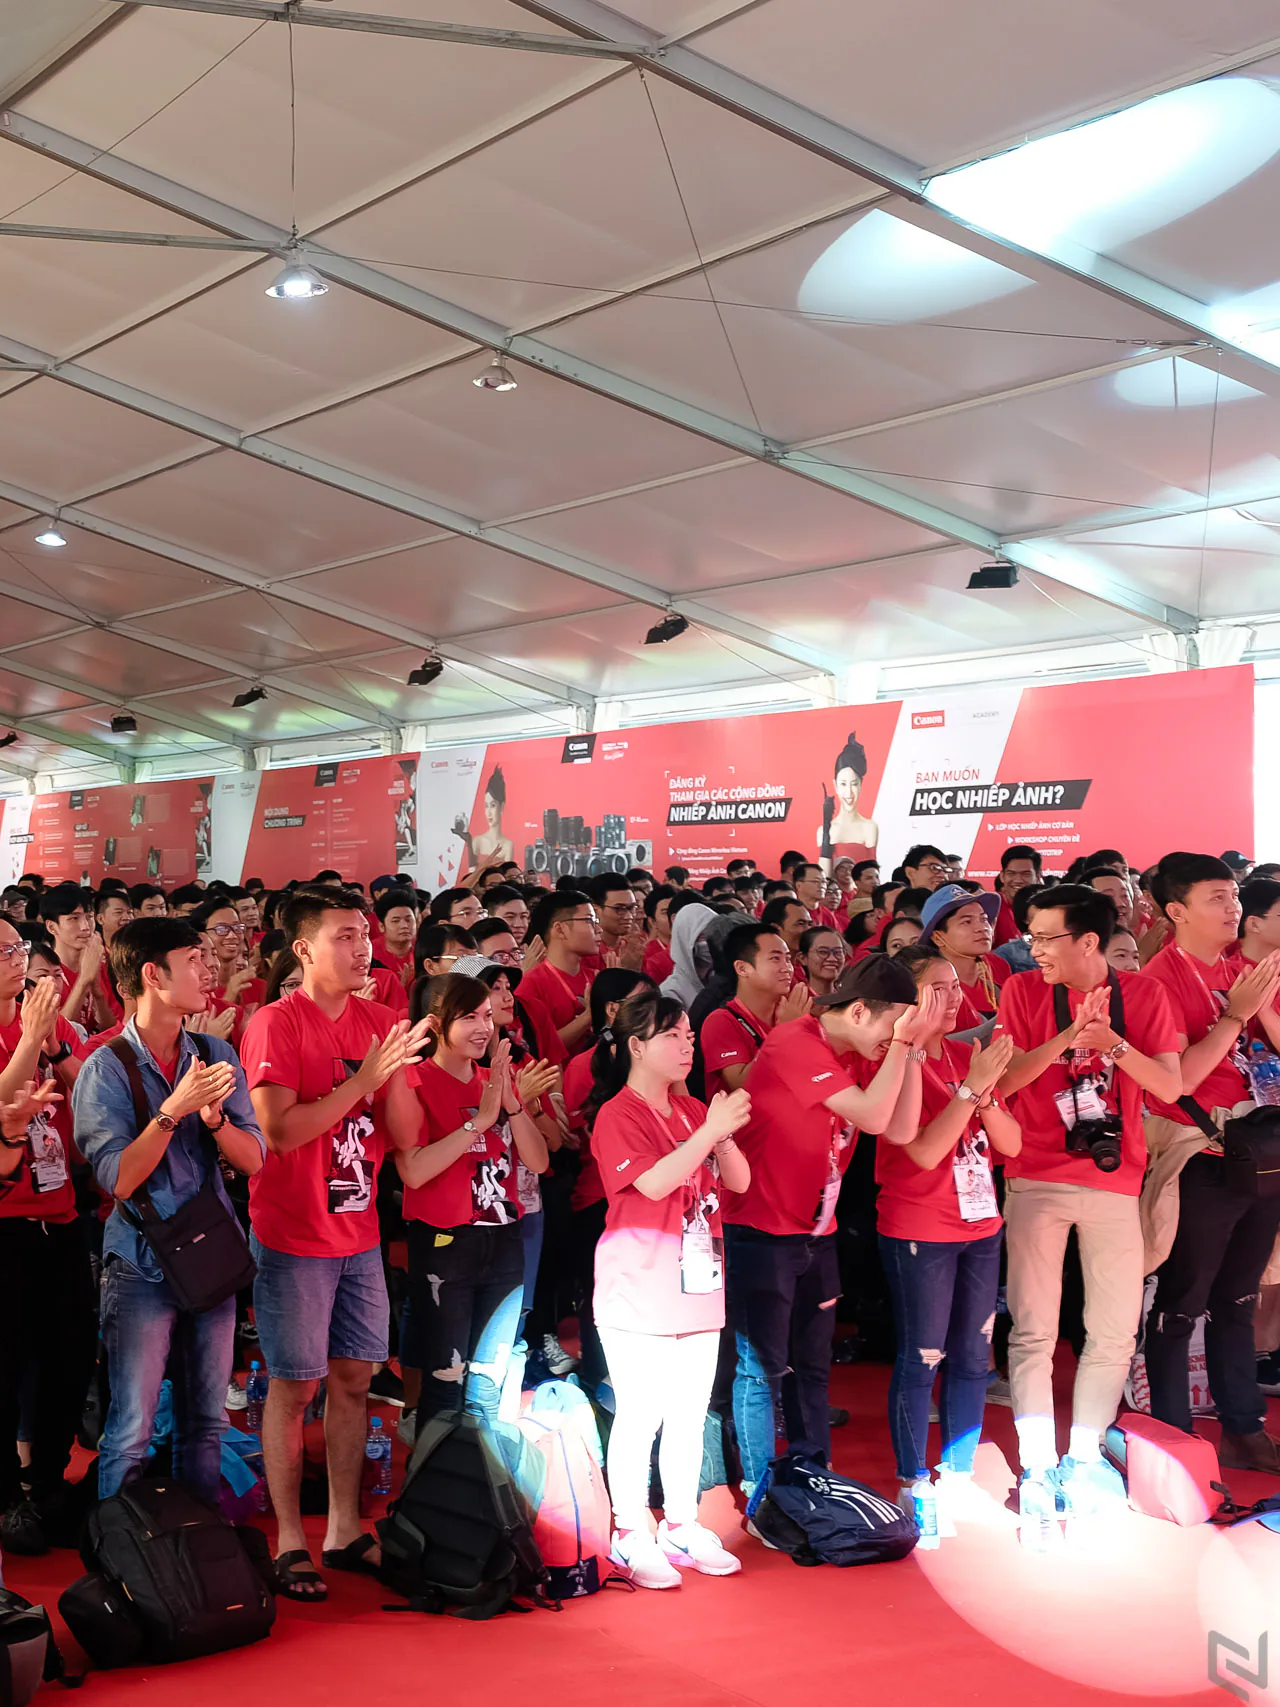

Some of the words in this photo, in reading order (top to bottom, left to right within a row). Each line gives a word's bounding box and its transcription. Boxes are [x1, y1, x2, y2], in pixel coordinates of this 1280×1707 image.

[913, 715, 944, 726] Canon
[669, 776, 694, 789] ĐĂNG
[915, 770, 939, 786] BẠN
[942, 764, 981, 782] MUỐN
[669, 791, 694, 802] THAM
[695, 790, 710, 801] GIA
[711, 787, 728, 800] CÁC
[729, 786, 756, 802] CỘNG
[757, 783, 786, 798] ĐỒNG
[914, 791, 953, 815] HỌC
[955, 781, 1010, 809] NHIẾP
[1011, 780, 1065, 807] ẢNH?
[669, 800, 707, 822] NHIẾP
[707, 800, 736, 821] ẢNH
[737, 801, 787, 820] CANON
[1014, 836, 1048, 844] WORKSHOP
